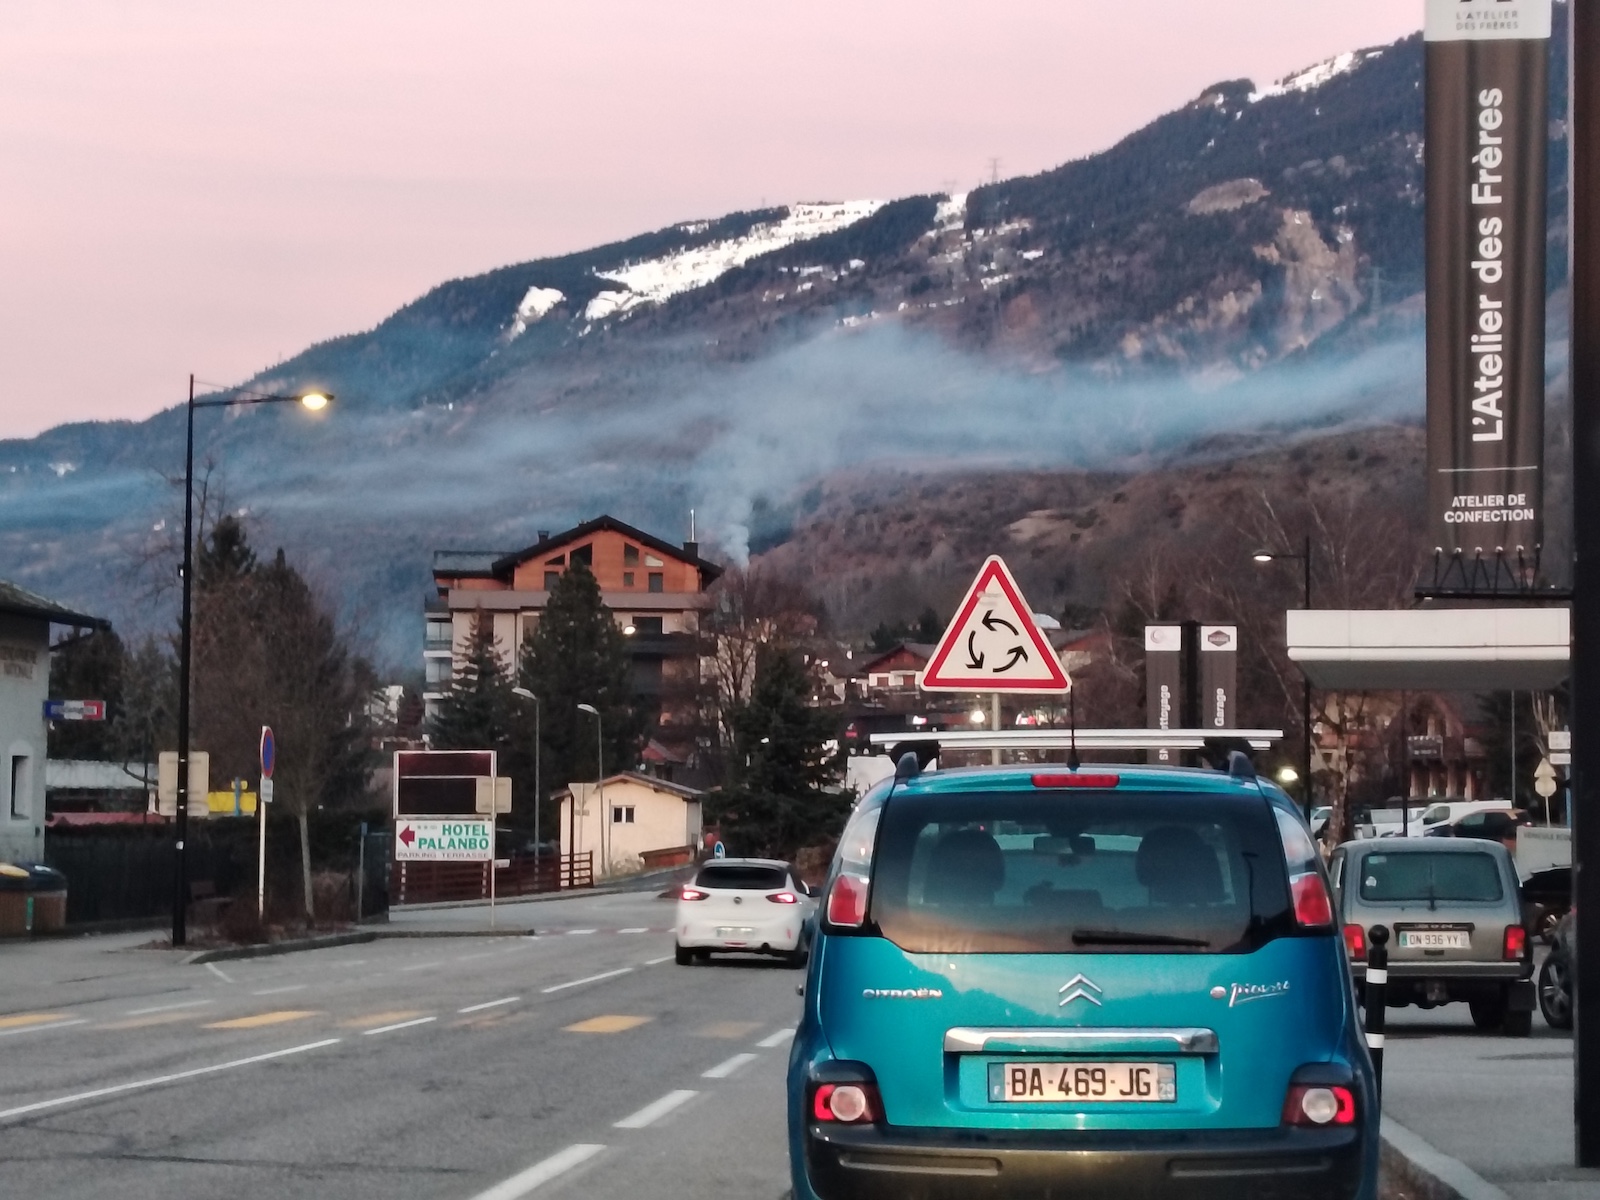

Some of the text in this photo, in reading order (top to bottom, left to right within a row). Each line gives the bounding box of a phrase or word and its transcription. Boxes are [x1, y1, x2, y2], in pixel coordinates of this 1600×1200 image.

[1456, 22, 1475, 31] DES
[1471, 88, 1503, 442] L'Atelier des Frères
[1452, 493, 1526, 508] ATELIER DE
[1444, 508, 1534, 523] CONFECTION
[1214, 688, 1226, 727] Garage
[442, 824, 489, 836] HOTEL
[418, 838, 489, 850] PALANBO
